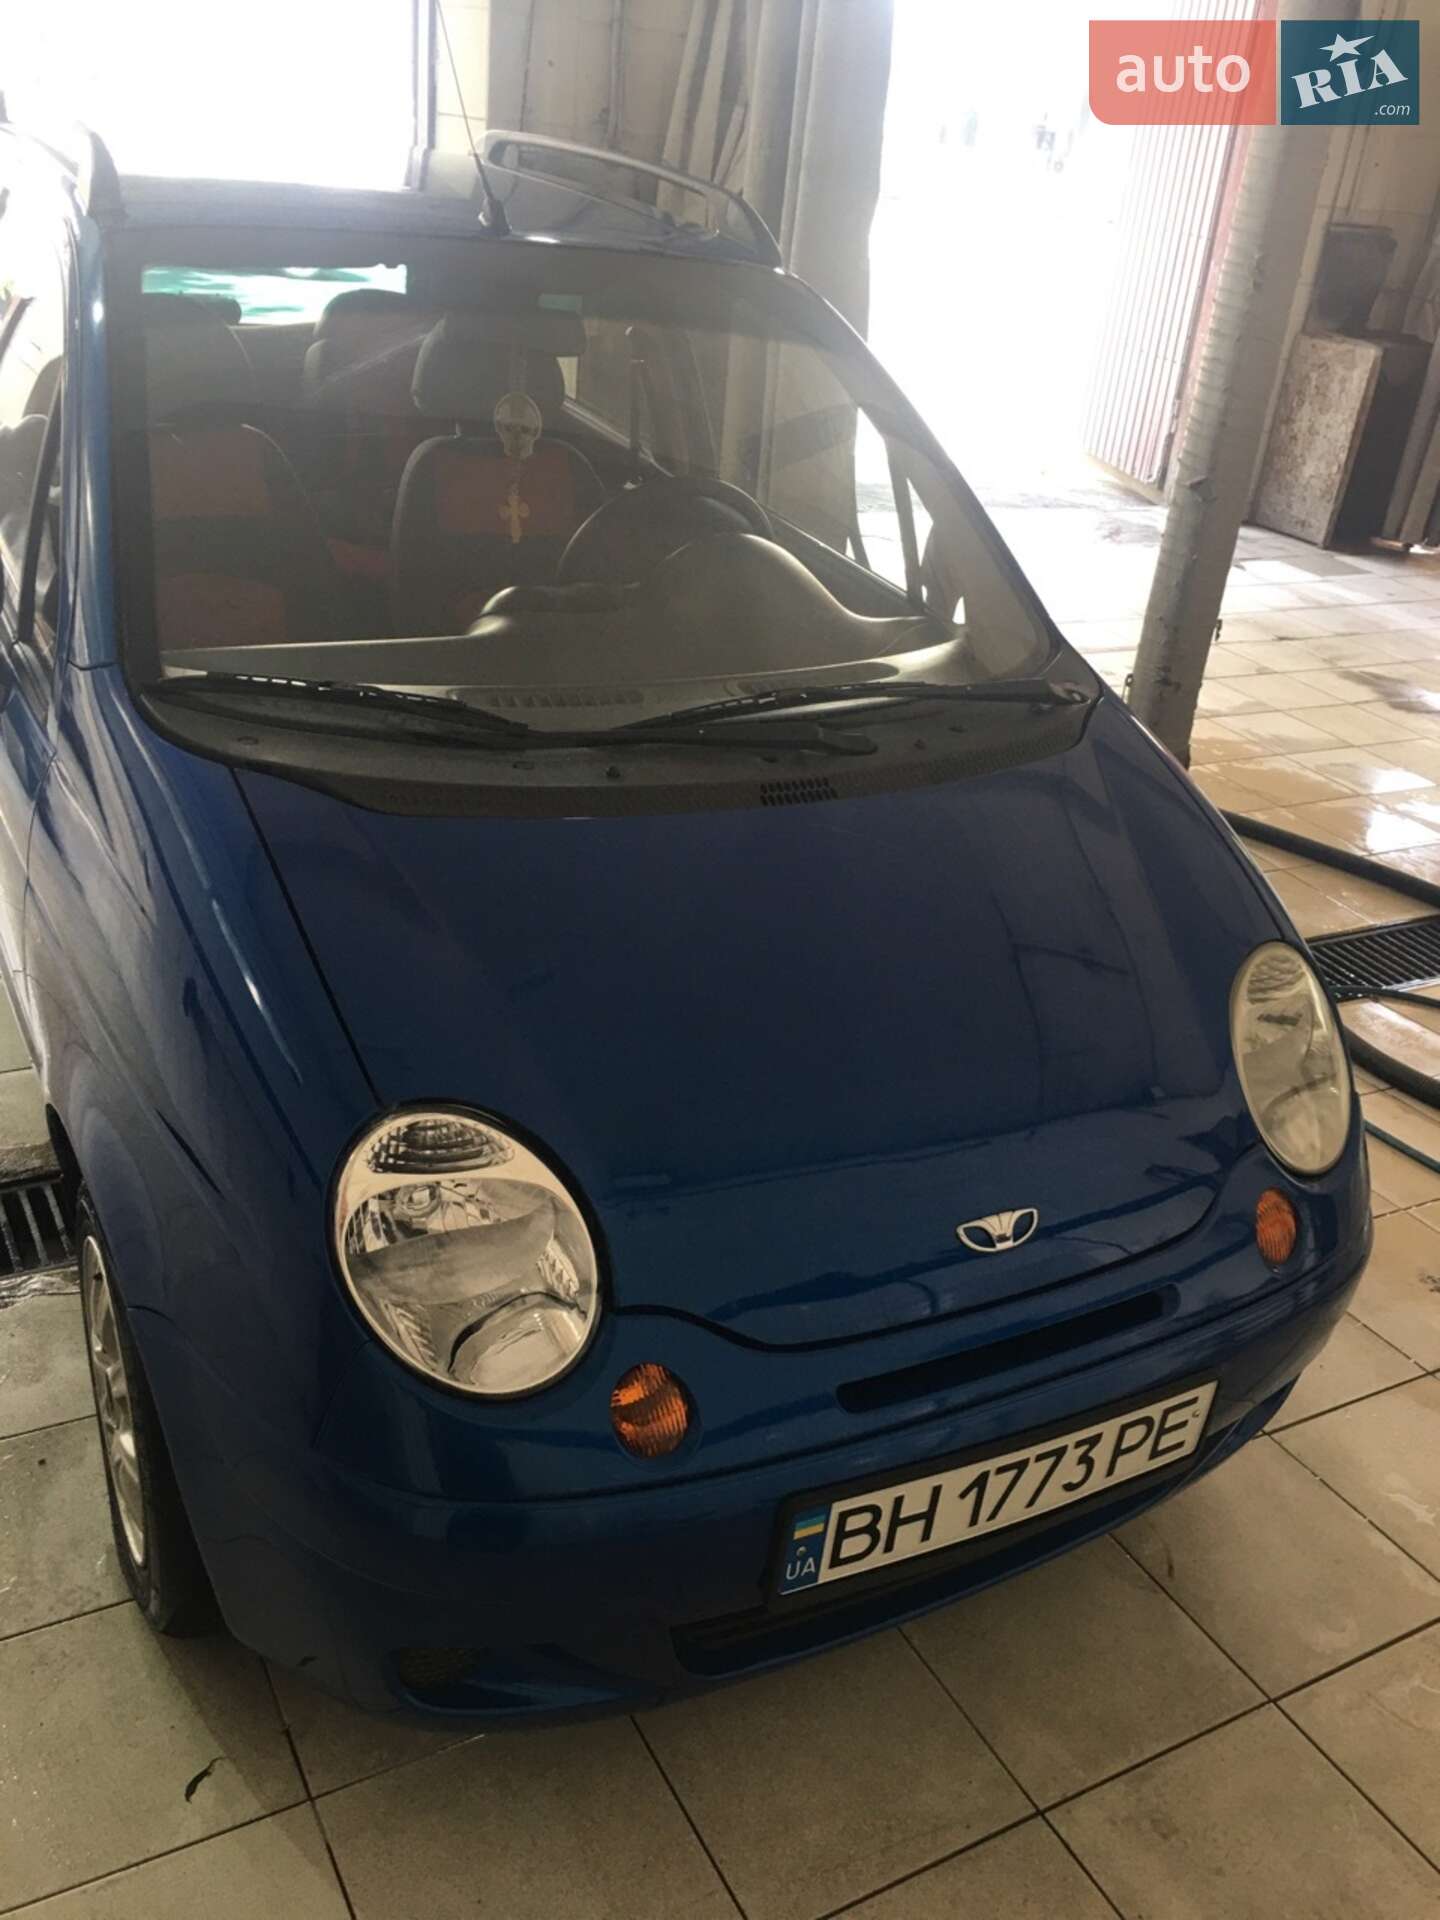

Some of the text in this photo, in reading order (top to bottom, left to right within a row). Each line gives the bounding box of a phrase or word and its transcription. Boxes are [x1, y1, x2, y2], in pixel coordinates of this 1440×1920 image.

[829, 1396, 1199, 1569] BH 1773 PE
[785, 1557, 816, 1581] UA
